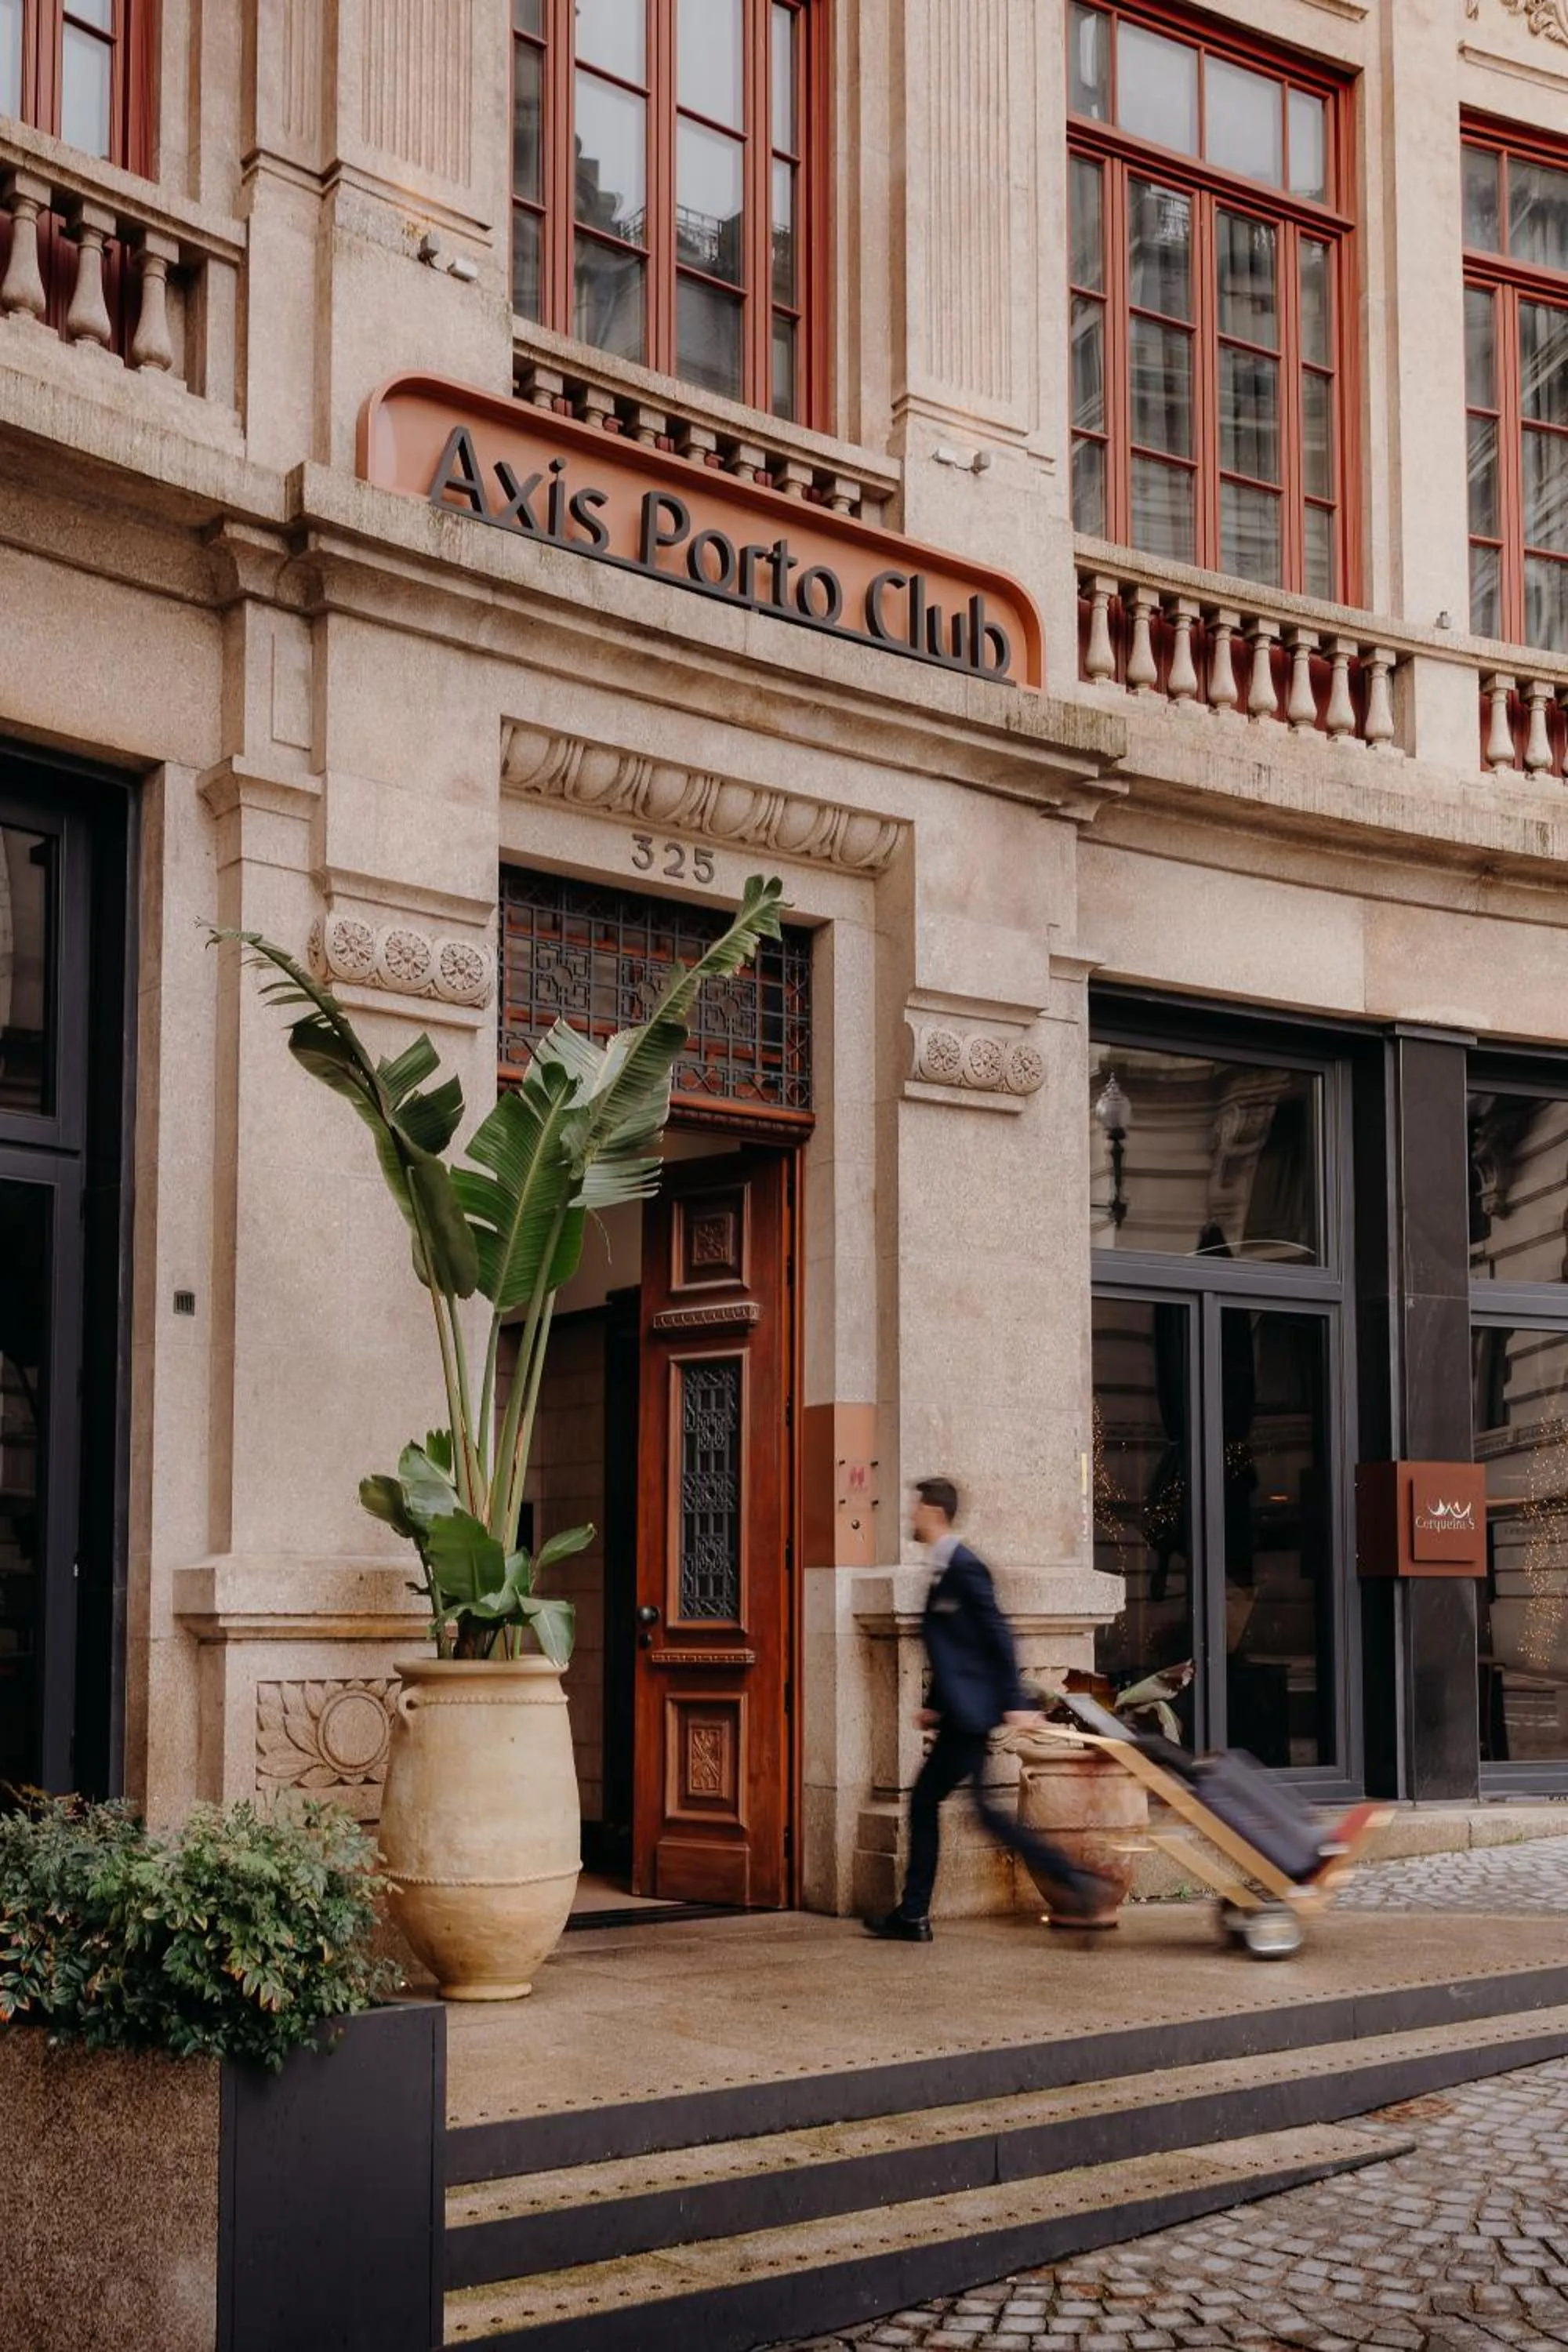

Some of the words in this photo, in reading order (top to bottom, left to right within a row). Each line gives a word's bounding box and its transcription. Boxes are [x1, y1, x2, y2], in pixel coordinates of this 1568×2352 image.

[430, 425, 610, 554] Axis
[639, 490, 844, 626] Porto
[865, 570, 1011, 679] Club
[631, 833, 715, 884] 325
